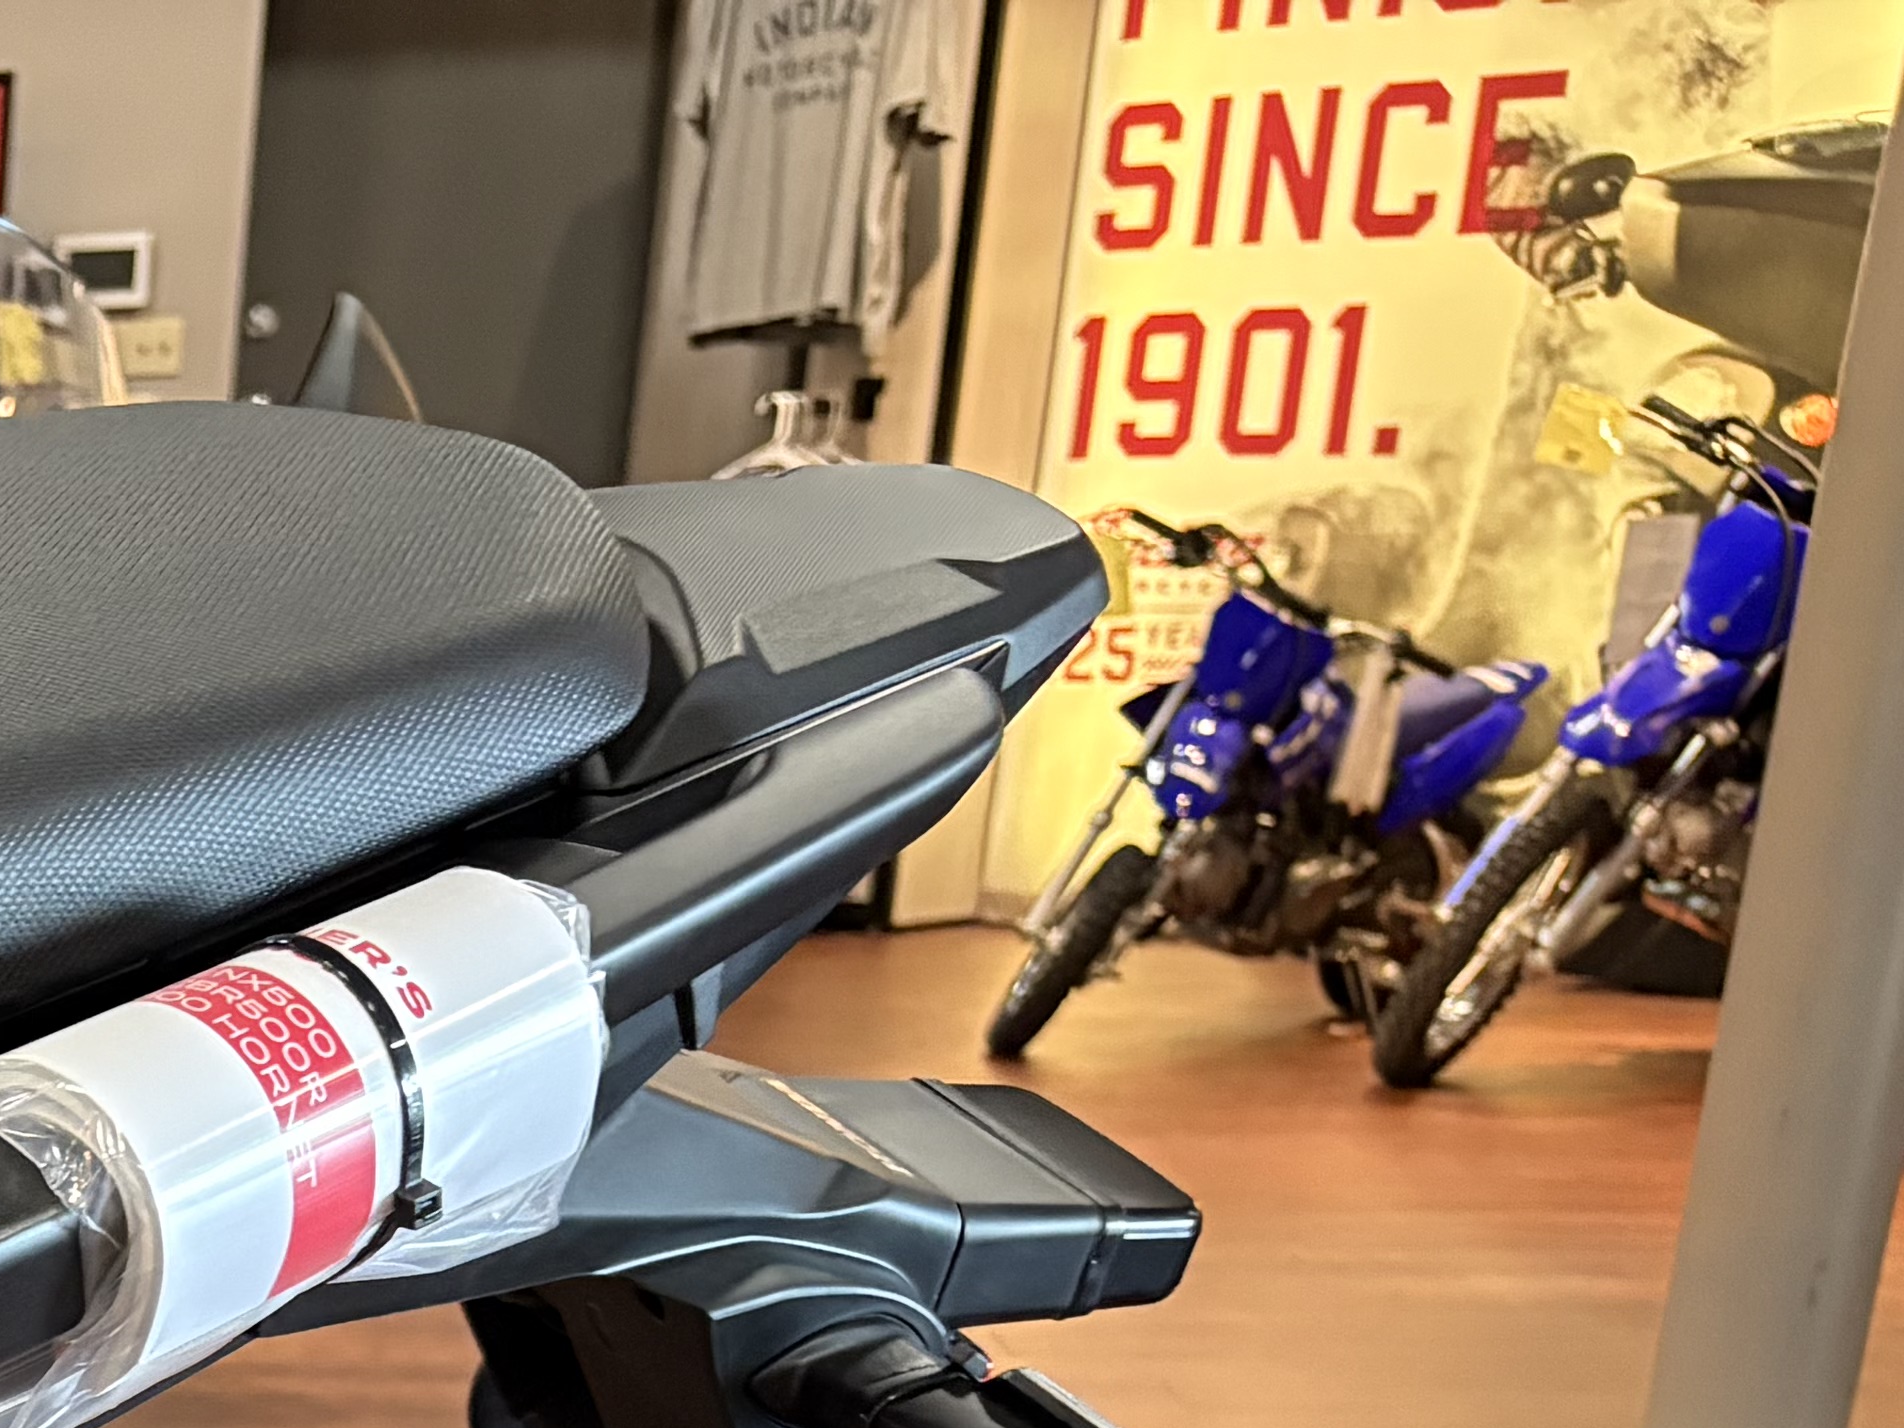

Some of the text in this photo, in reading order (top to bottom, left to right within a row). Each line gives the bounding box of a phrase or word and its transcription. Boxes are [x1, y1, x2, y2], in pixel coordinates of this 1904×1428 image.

[1094, 70, 1569, 251] SINCE
[1067, 306, 1398, 459] 1901.
[213, 968, 338, 1059] NX500
[310, 927, 434, 1019] ER'S
